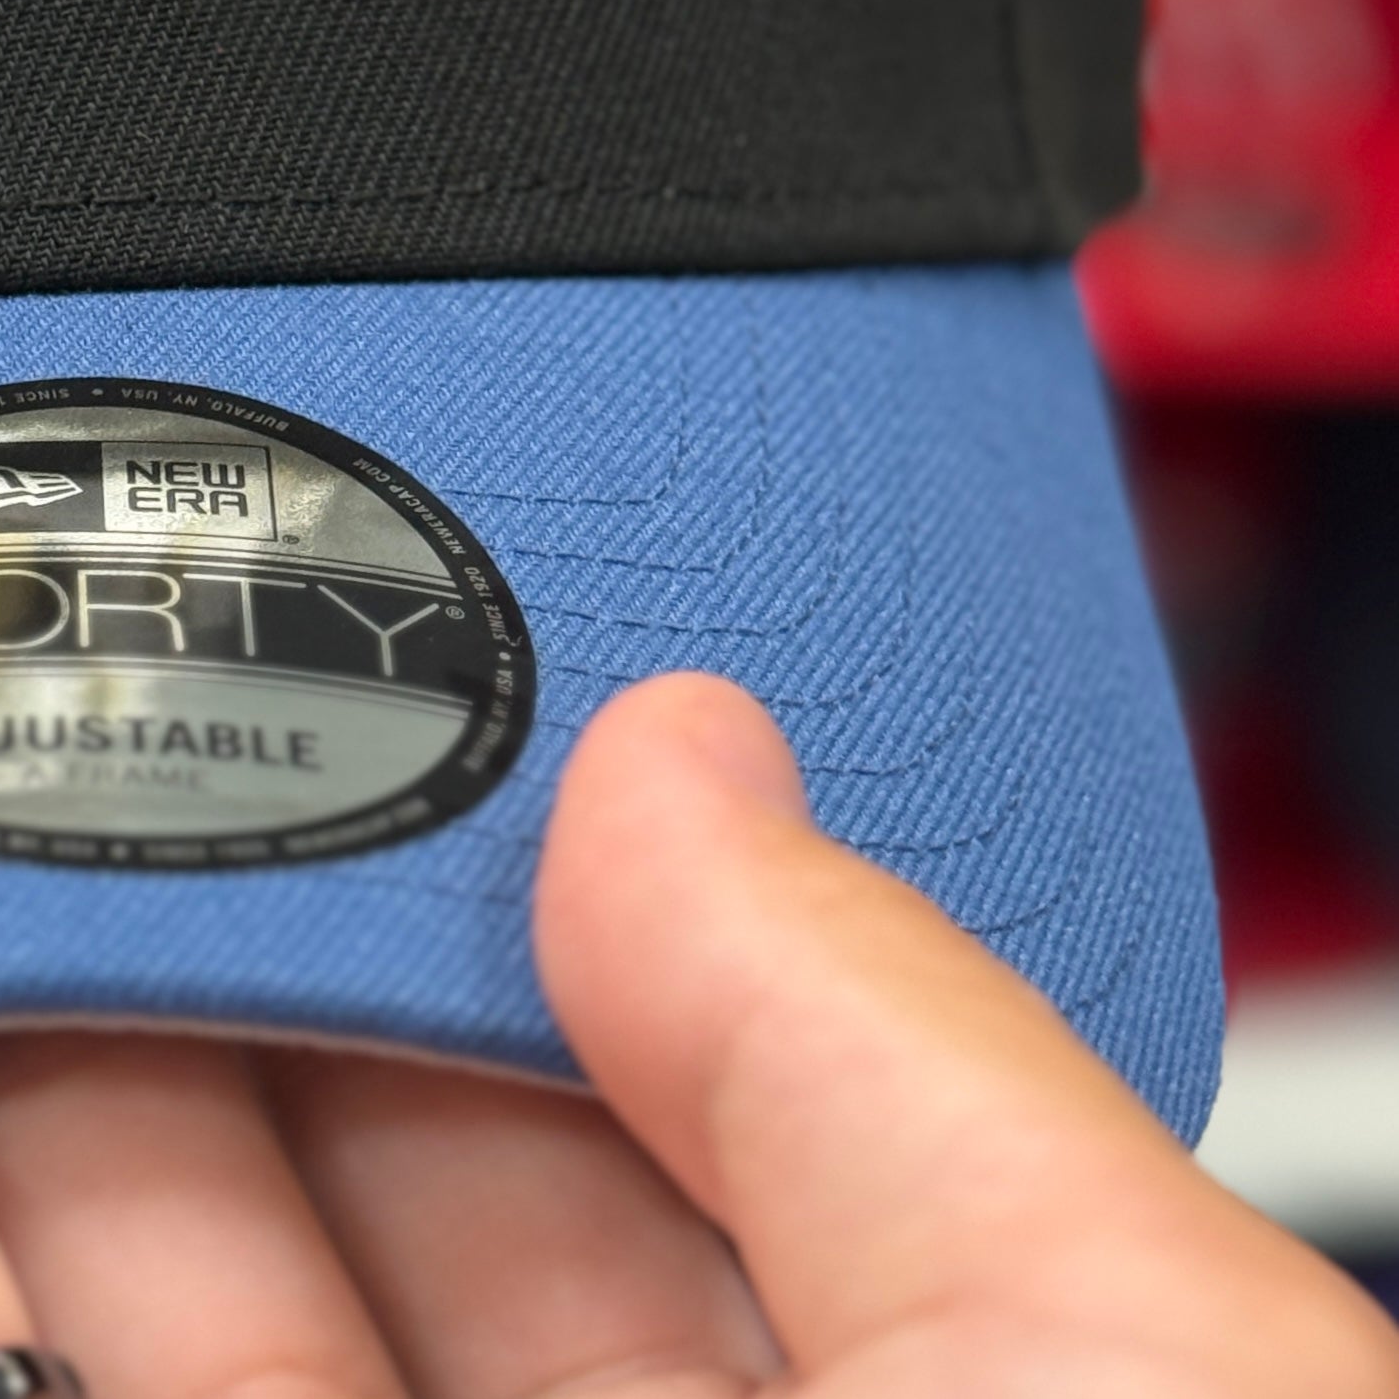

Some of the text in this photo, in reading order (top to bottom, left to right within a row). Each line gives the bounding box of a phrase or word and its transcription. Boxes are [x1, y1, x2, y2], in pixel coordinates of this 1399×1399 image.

[13, 387, 71, 405] SINCE
[121, 387, 159, 401] USA
[125, 460, 247, 490] NEW
[127, 486, 250, 518] ERA
[352, 457, 467, 555] NEWERACAP.COM
[463, 566, 494, 599] 1920
[482, 602, 508, 642] SINCE
[495, 668, 514, 696] USA
